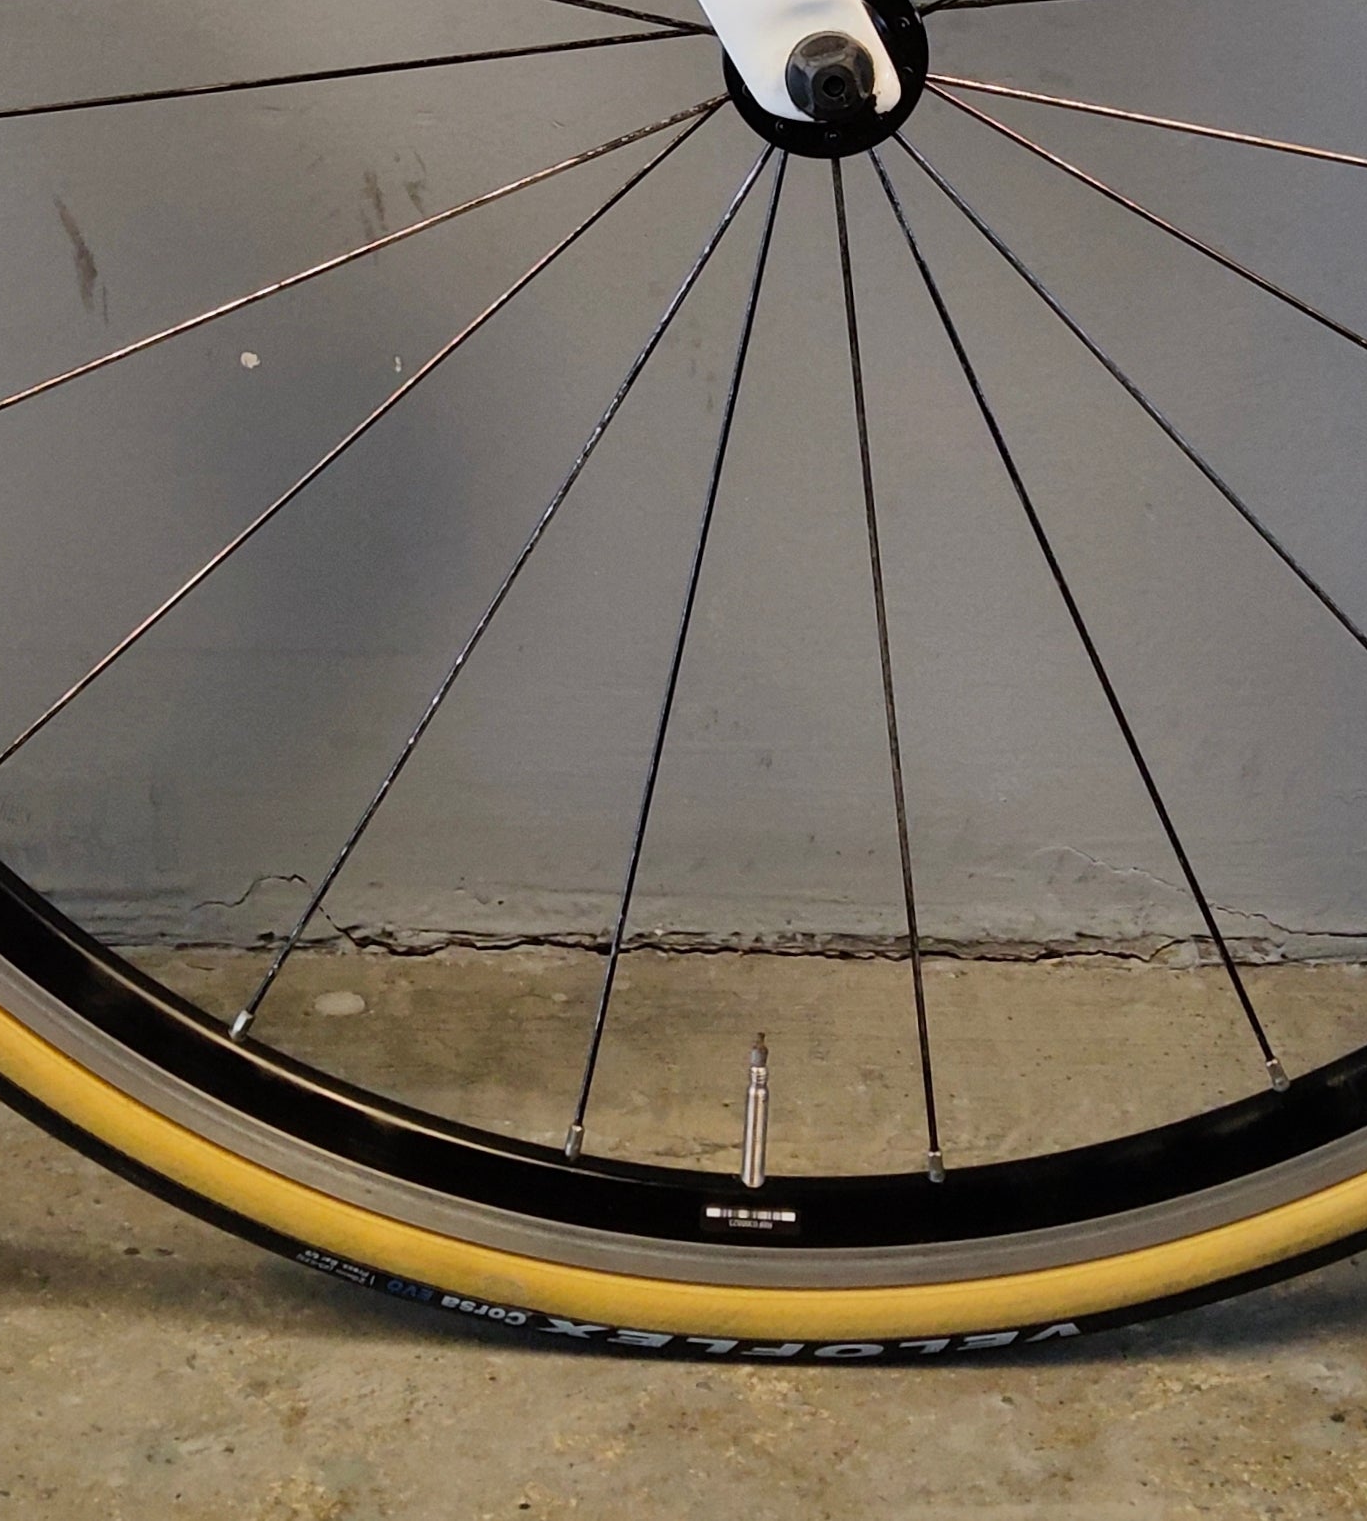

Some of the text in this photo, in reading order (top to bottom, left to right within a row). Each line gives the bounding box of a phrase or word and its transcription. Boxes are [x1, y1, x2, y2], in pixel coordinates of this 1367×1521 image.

[386, 1279, 1081, 1358] VELOFLEX Corsa EVO
